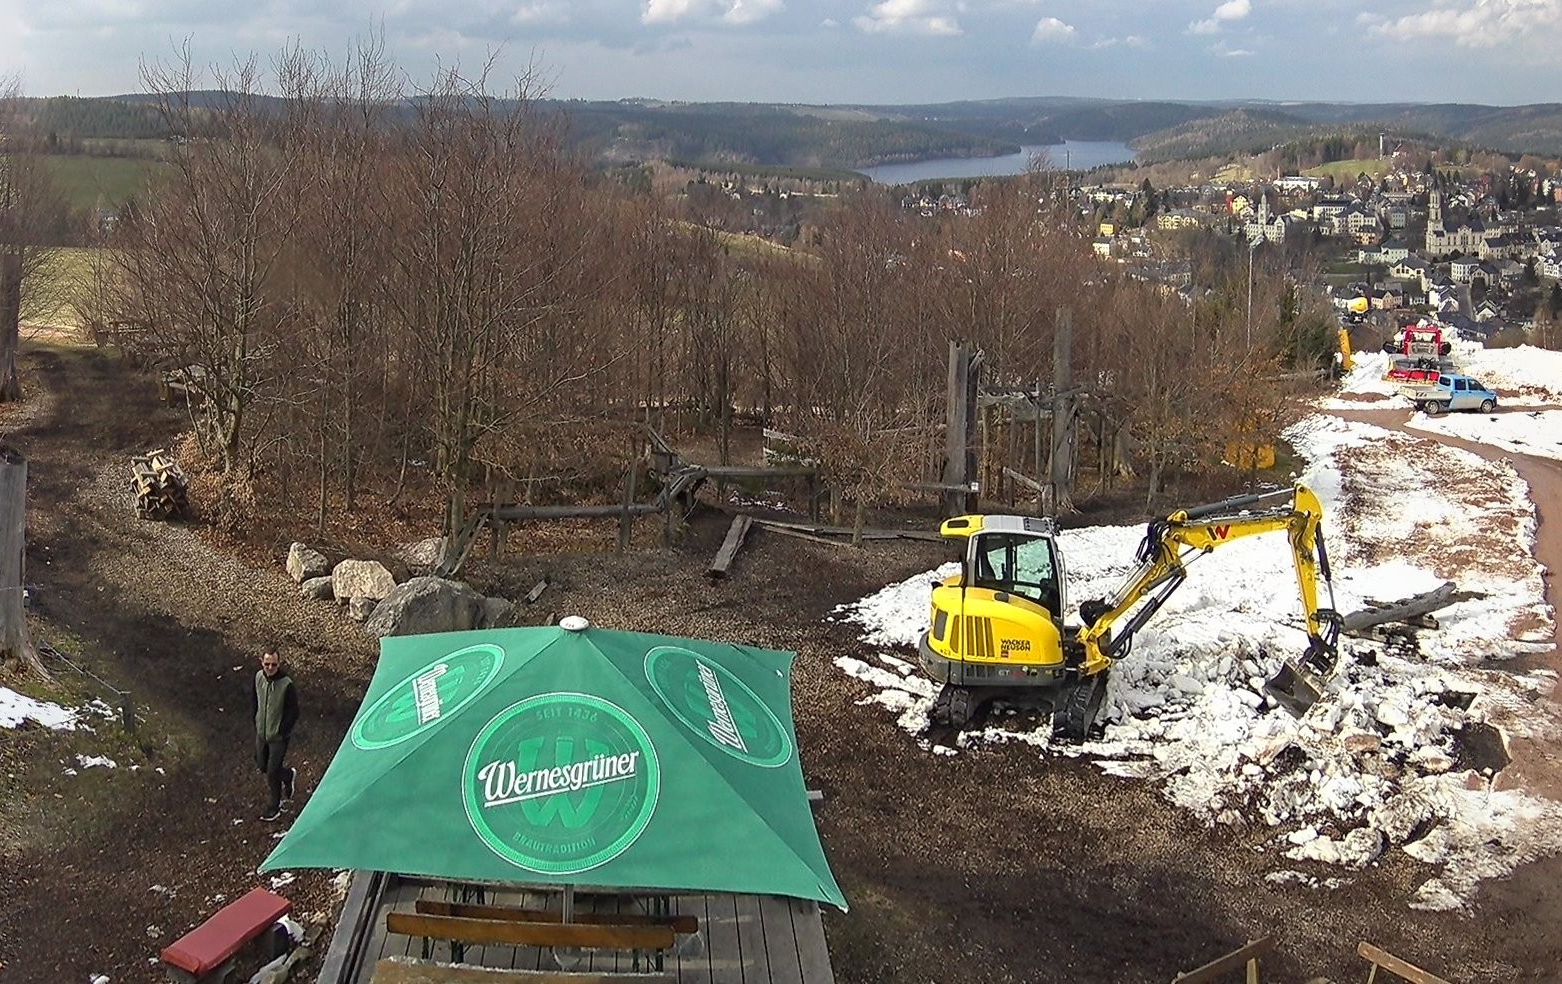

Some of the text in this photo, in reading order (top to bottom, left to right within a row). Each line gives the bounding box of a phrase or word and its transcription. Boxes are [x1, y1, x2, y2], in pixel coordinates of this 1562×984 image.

[536, 707, 563, 720] SEIT
[477, 750, 640, 803] Wernesgrüner
[512, 831, 597, 854] BRAUTRADITION
